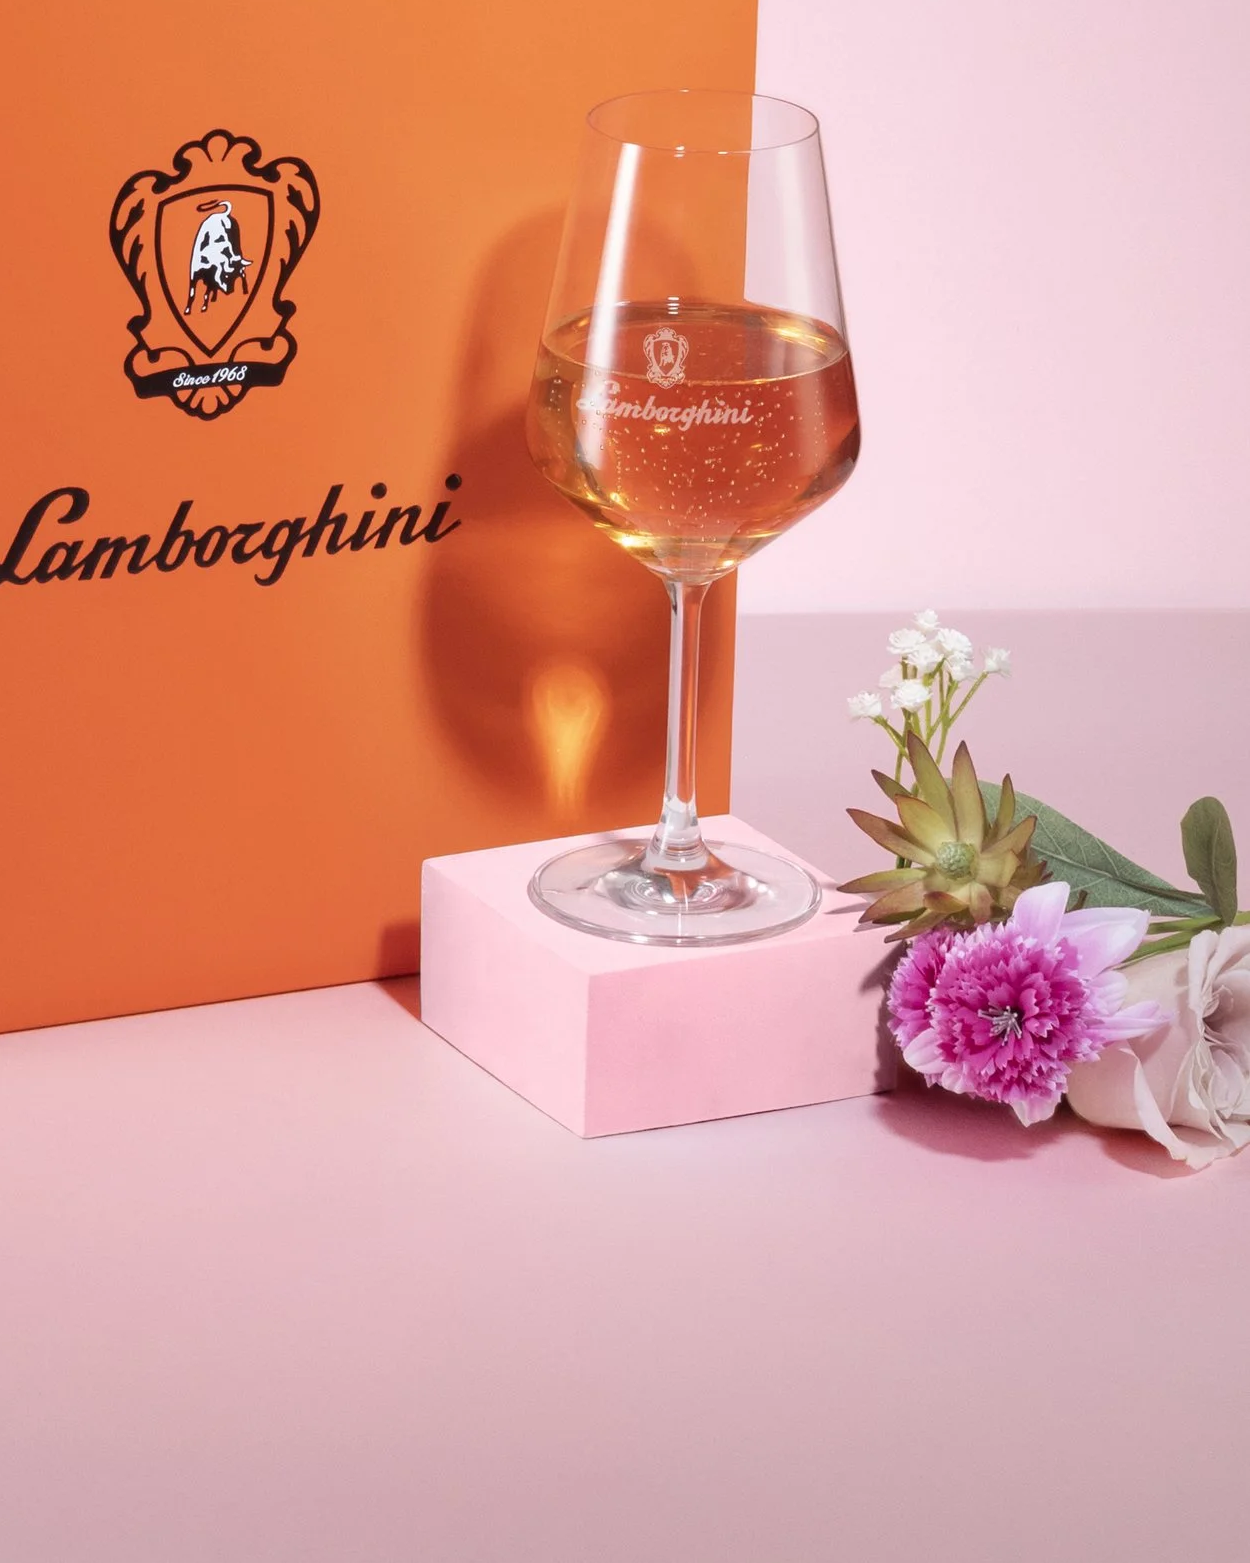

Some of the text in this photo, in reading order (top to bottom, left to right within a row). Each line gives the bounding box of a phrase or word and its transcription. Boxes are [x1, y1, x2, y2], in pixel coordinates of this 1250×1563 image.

[172, 365, 248, 388] Since 1968
[575, 380, 755, 432] Lamborghini
